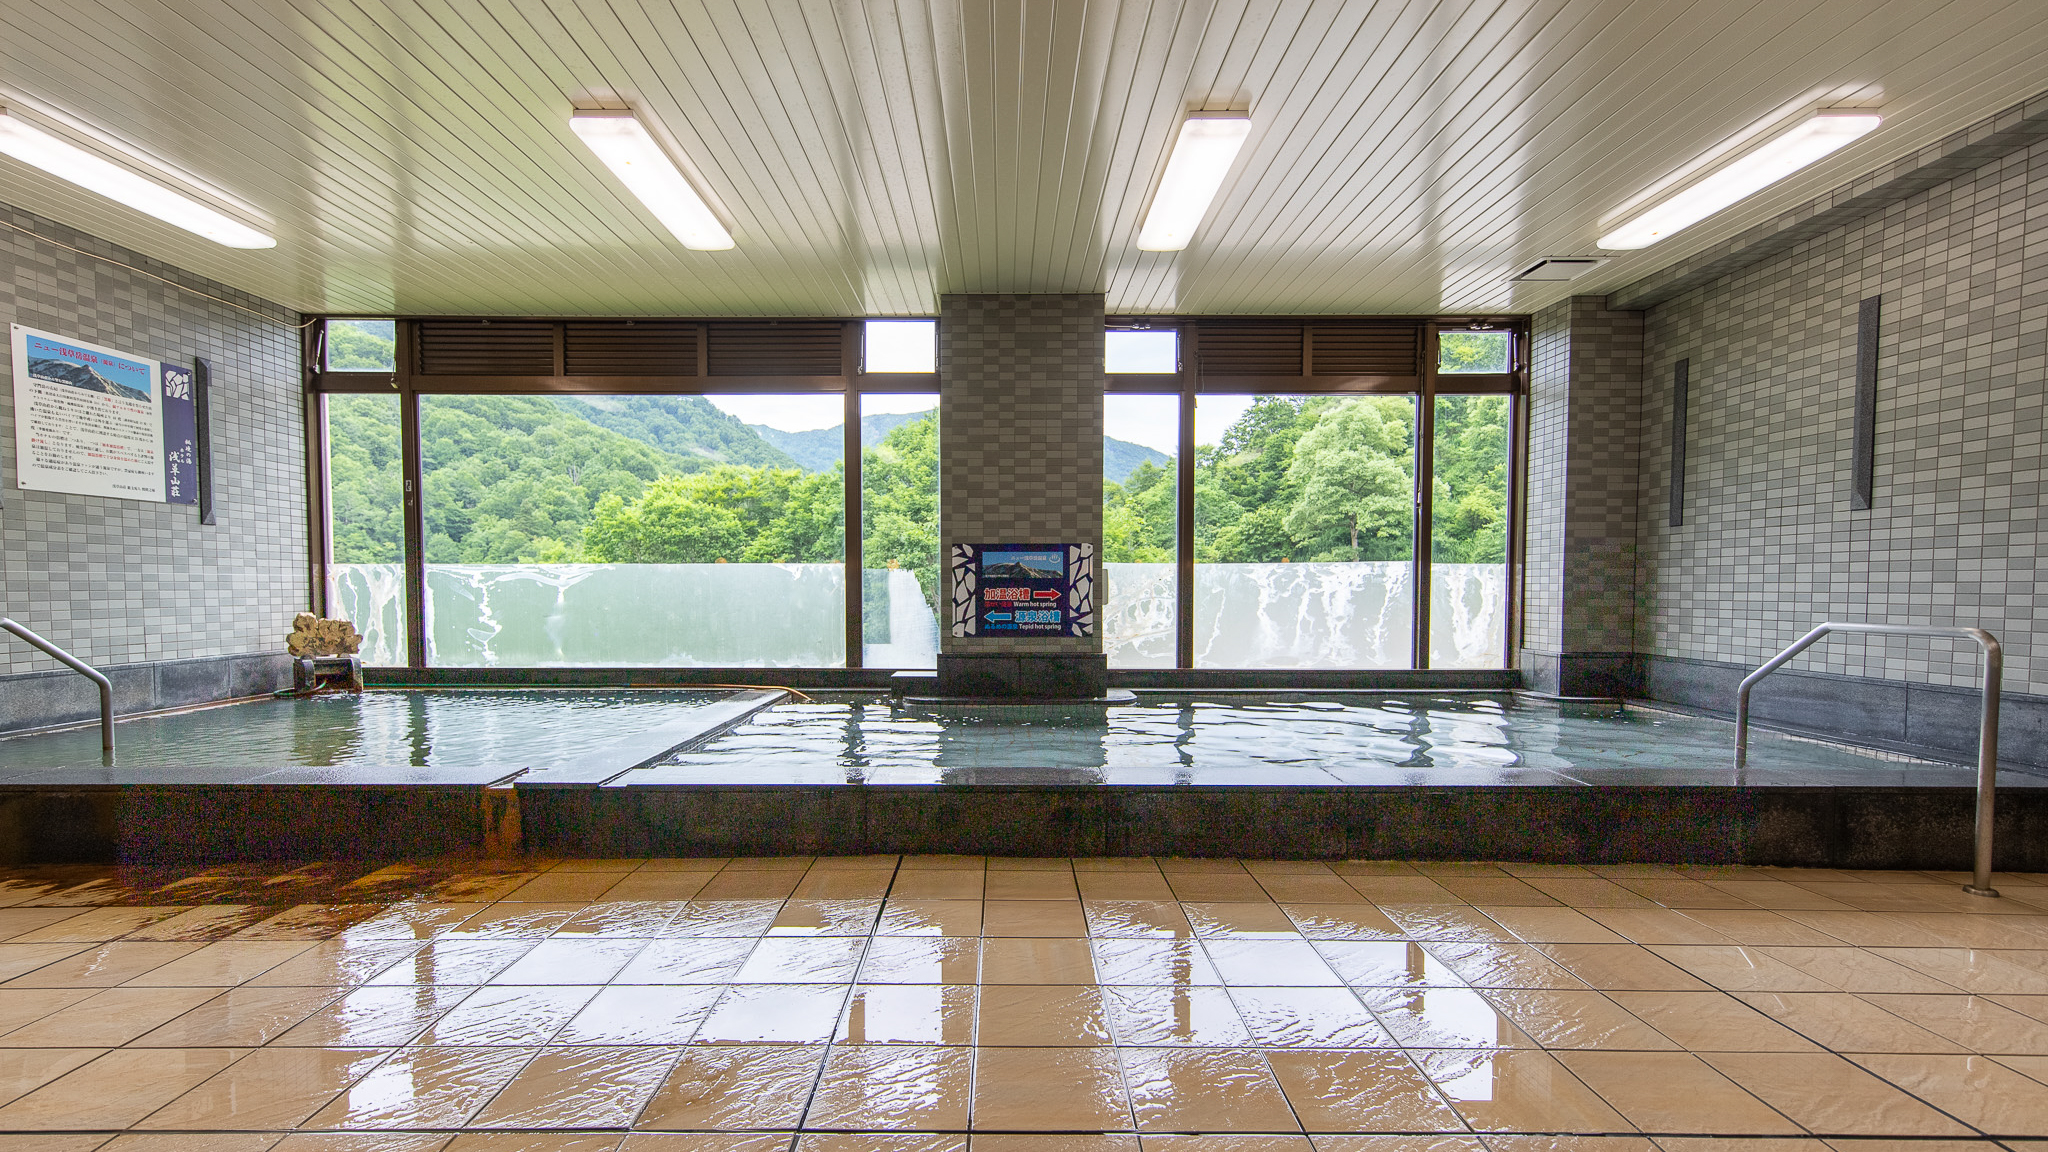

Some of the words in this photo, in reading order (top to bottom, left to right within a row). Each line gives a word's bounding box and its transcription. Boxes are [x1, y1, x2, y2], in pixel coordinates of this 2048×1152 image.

[168, 451, 181, 498] 浅草山荘
[984, 588, 1031, 601] 加温浴槽
[1014, 610, 1061, 623] 源泉浴槽
